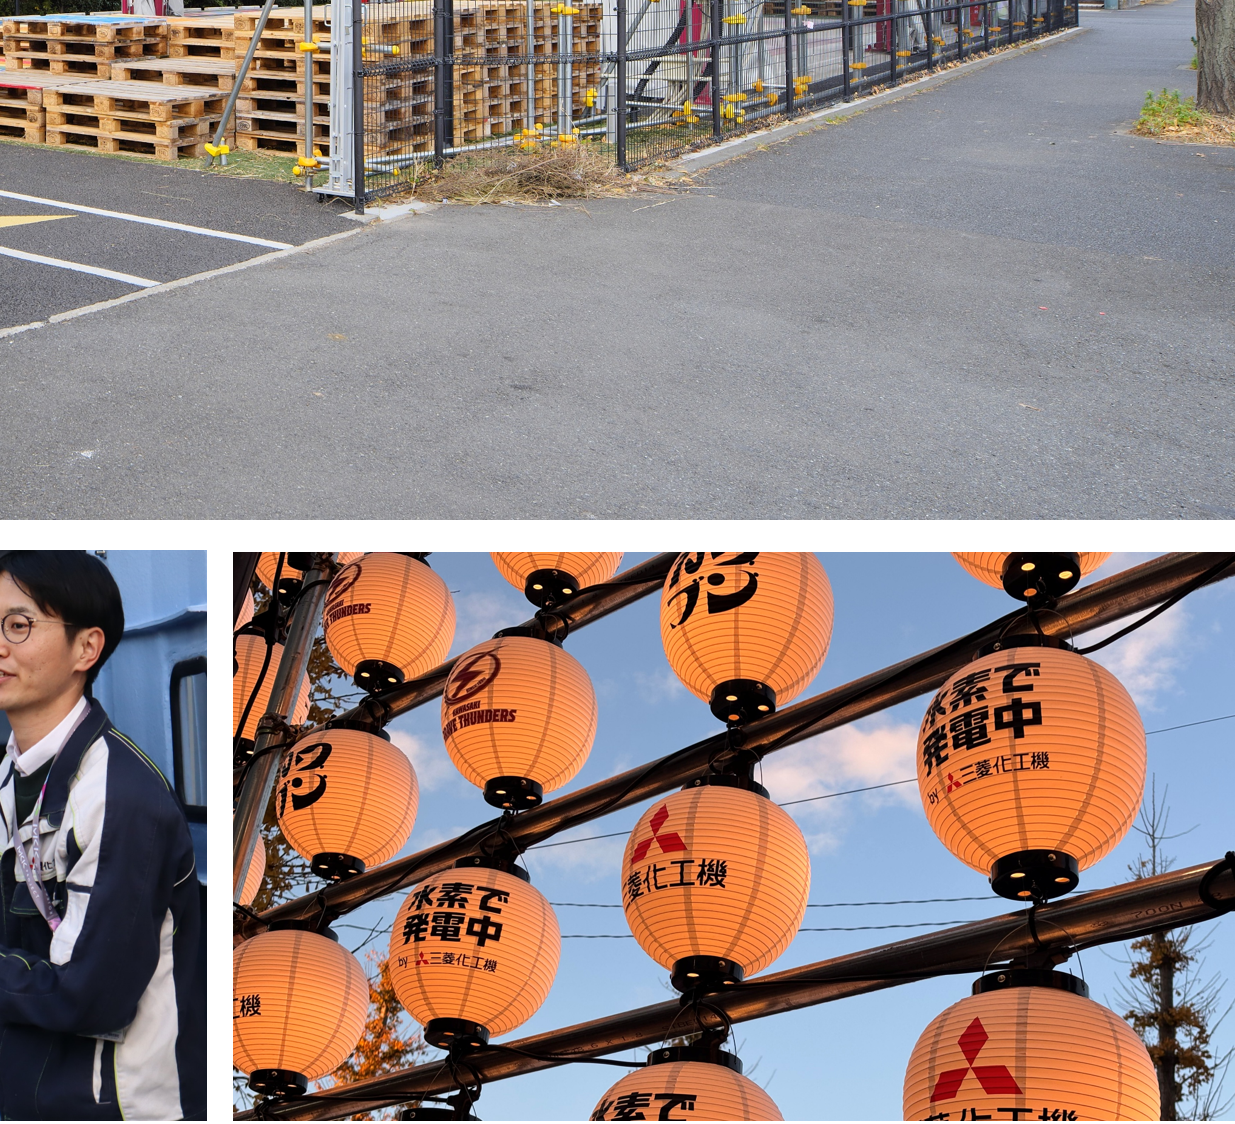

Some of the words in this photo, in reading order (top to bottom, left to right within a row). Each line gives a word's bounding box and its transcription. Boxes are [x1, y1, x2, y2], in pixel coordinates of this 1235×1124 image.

[329, 603, 371, 625] THUNDERS
[923, 662, 1041, 734] 水素で
[458, 709, 517, 730] THUNDERS
[923, 697, 1043, 777] 発電中
[927, 788, 940, 805] by
[959, 751, 1050, 785] 三菱化工機
[407, 881, 510, 914] 水素で
[402, 911, 503, 947] 発電中
[397, 956, 408, 968] by
[429, 951, 498, 973] 三菱化工機
